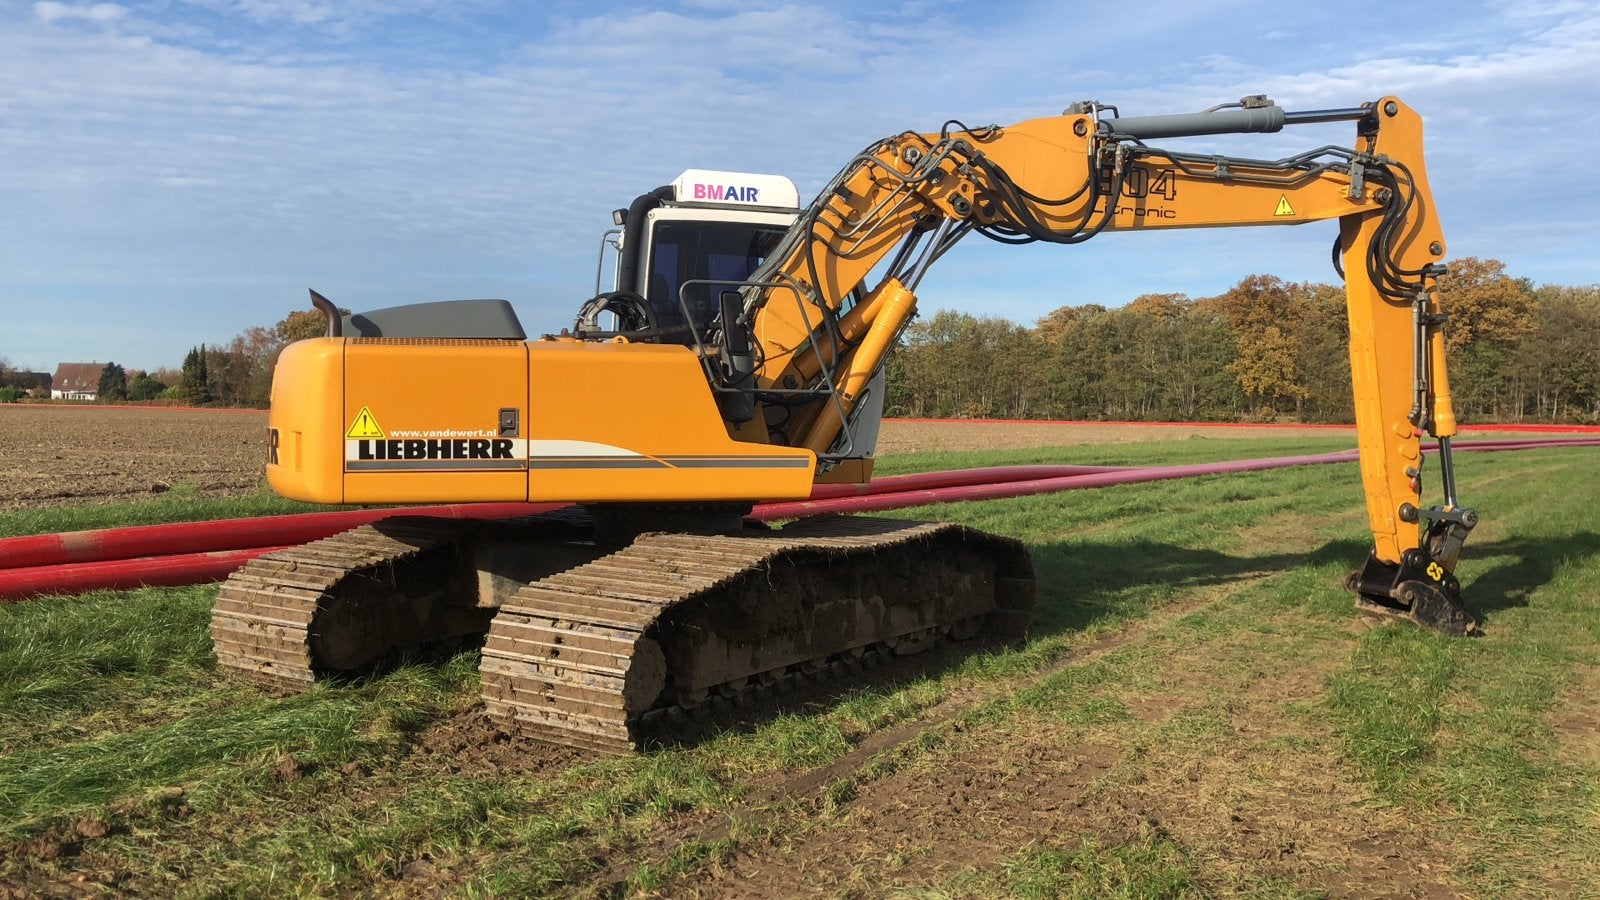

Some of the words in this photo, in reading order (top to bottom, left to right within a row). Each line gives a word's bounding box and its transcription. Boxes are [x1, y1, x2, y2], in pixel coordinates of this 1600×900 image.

[694, 183, 758, 202] BMAIR
[390, 428, 497, 438] www.vandewert.nl
[358, 439, 514, 459] LIEBHERR
